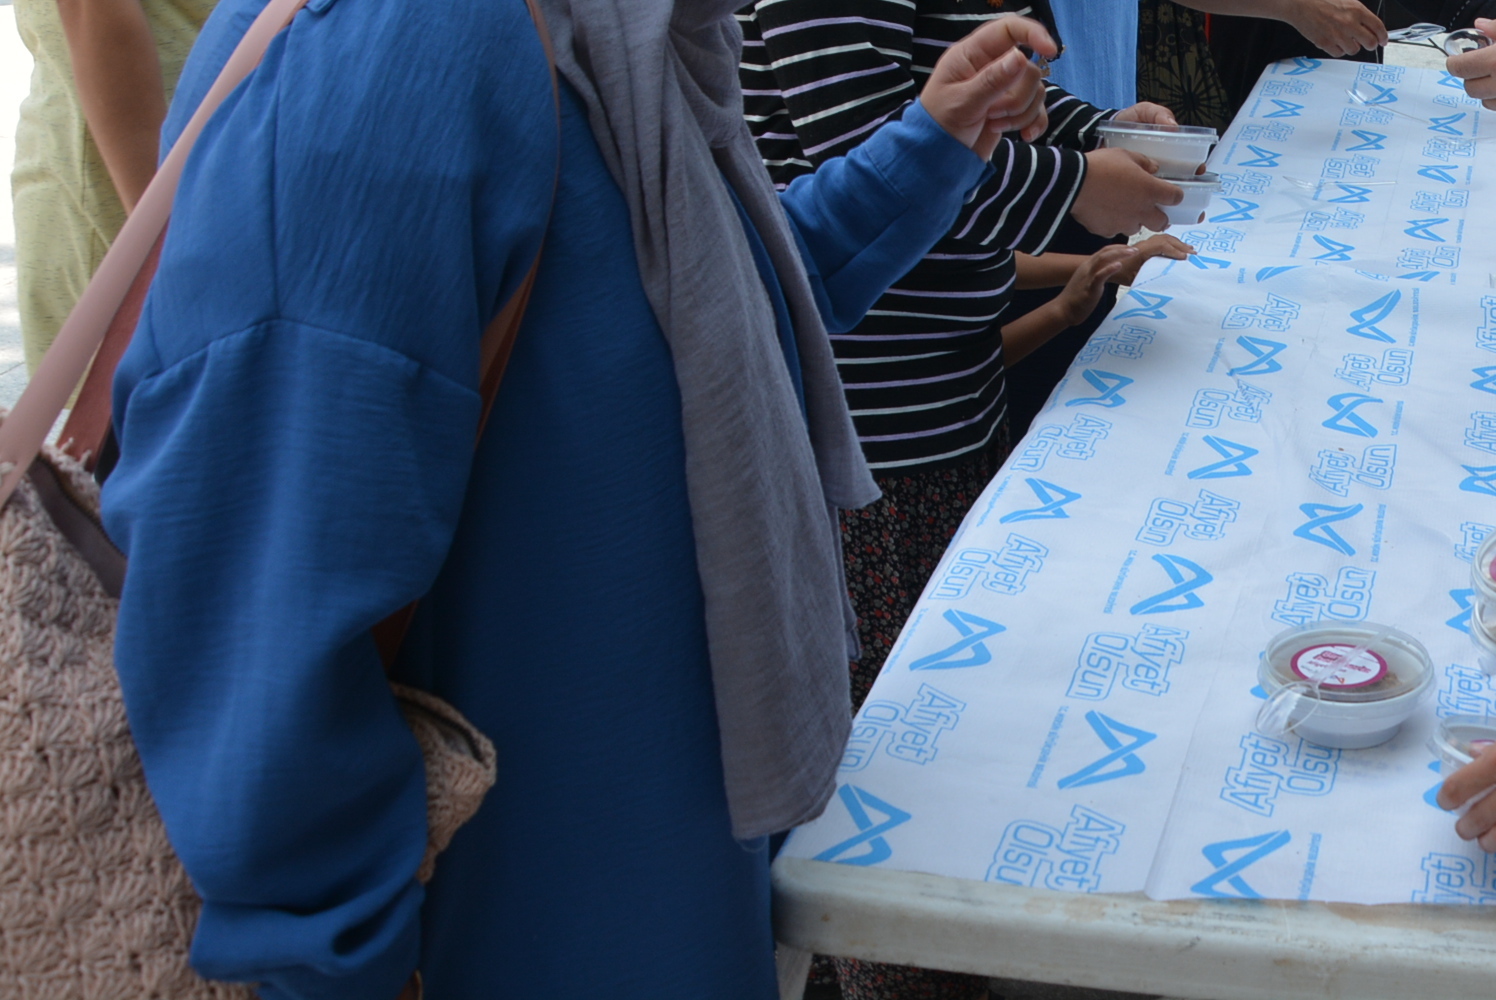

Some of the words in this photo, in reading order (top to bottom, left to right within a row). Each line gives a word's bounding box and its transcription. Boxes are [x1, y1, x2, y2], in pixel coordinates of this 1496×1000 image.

[1375, 349, 1411, 385] Olsun
[1188, 389, 1233, 428] Olsun
[1058, 414, 1110, 459] Afiyet
[1311, 451, 1353, 496] Afiyet
[1352, 445, 1395, 488] Olsun
[1185, 491, 1238, 540] Afiyet
[933, 550, 994, 598] Olsun
[983, 535, 1046, 594] Afiyet
[1323, 568, 1372, 619] Olsun
[1070, 634, 1134, 699] Olsun
[1125, 625, 1187, 695] Afiyet
[889, 686, 963, 764] Afiyet
[1222, 735, 1287, 814] Afiyet
[1283, 742, 1336, 793] Olsu
[992, 821, 1060, 886] Olsu
[1048, 807, 1122, 891] Afiyet
